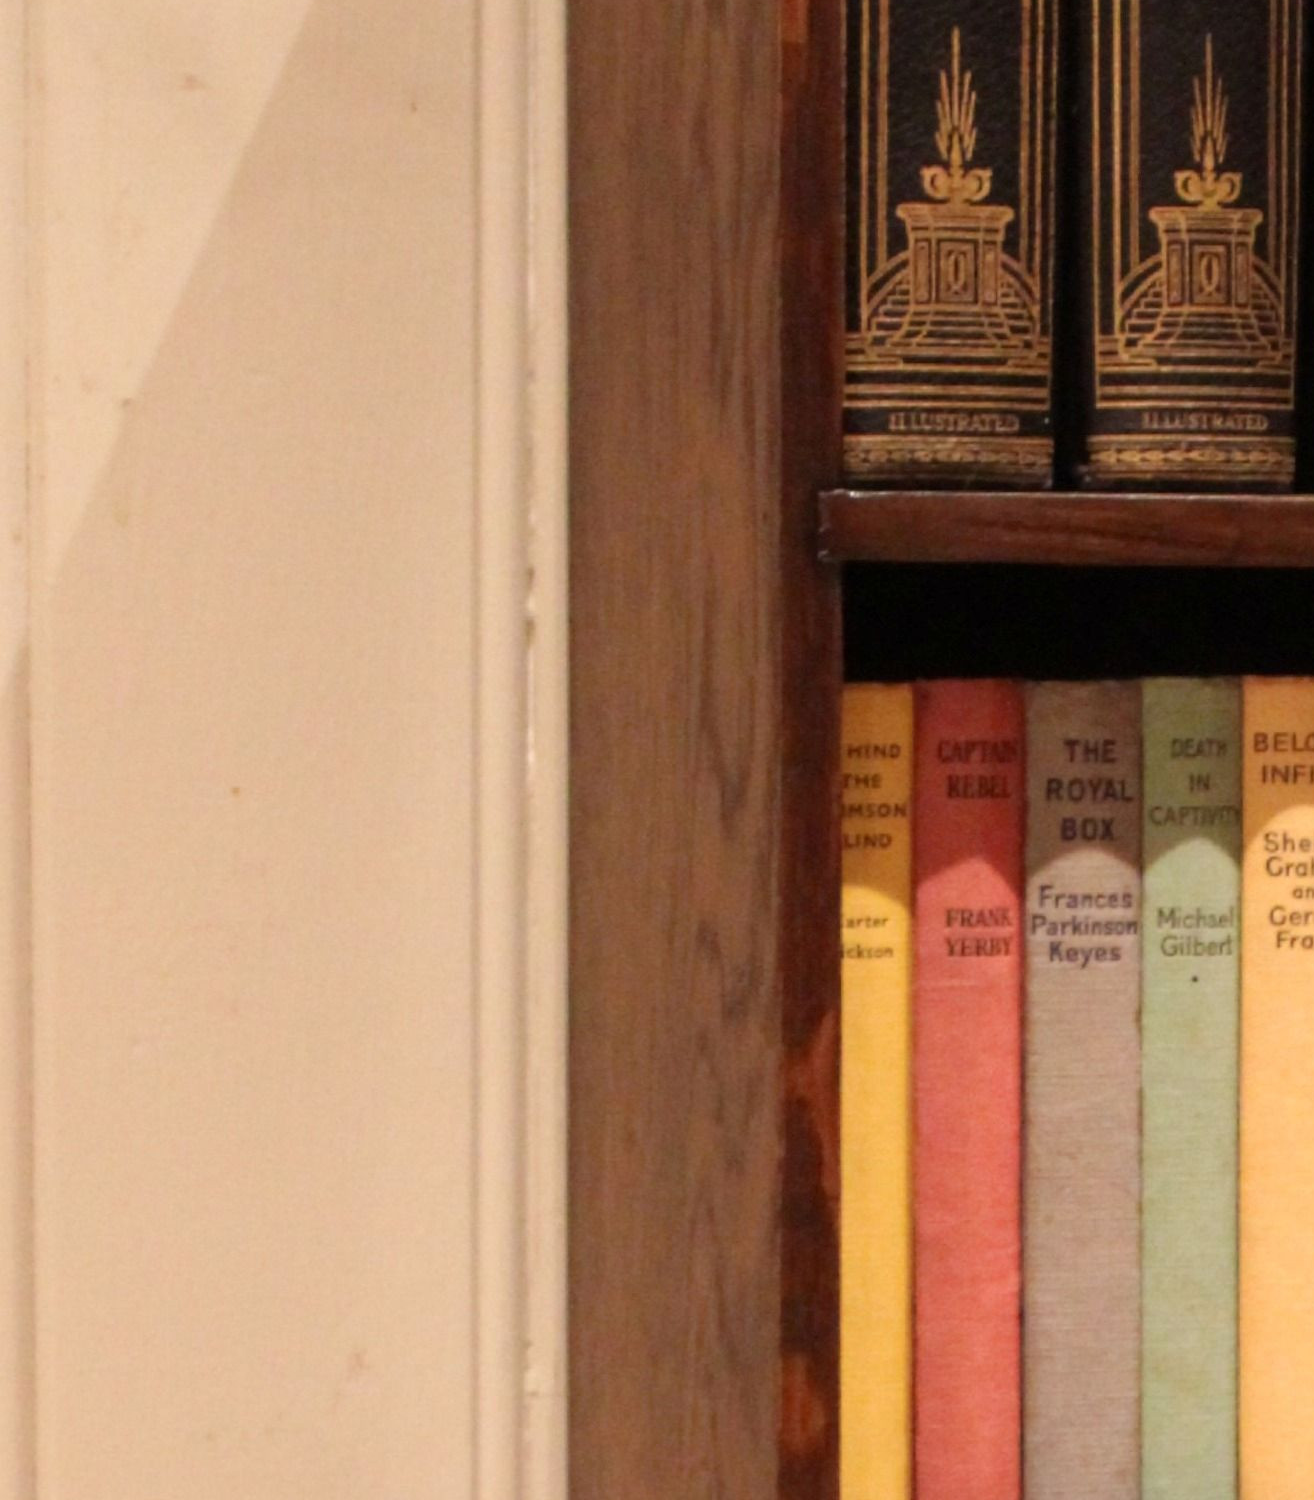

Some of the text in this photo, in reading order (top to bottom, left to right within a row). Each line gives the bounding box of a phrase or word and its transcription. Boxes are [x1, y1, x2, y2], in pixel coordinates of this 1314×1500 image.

[888, 411, 1020, 434] ILLUSTRATED
[1141, 411, 1269, 433] ILLUSTRATED
[1065, 739, 1117, 763] THE
[1171, 738, 1227, 758] DEATH
[1045, 777, 1134, 801] ROYAL
[1188, 774, 1210, 791] IN
[1060, 817, 1115, 842] BOX
[1039, 885, 1133, 908] Frances
[945, 908, 1012, 928] FRANK
[1031, 914, 1138, 936] Parkinson
[1156, 907, 1234, 929] Michael
[945, 938, 1012, 957] YERBY
[1049, 941, 1122, 970] Keyes
[1160, 935, 1233, 958] Gilbert
